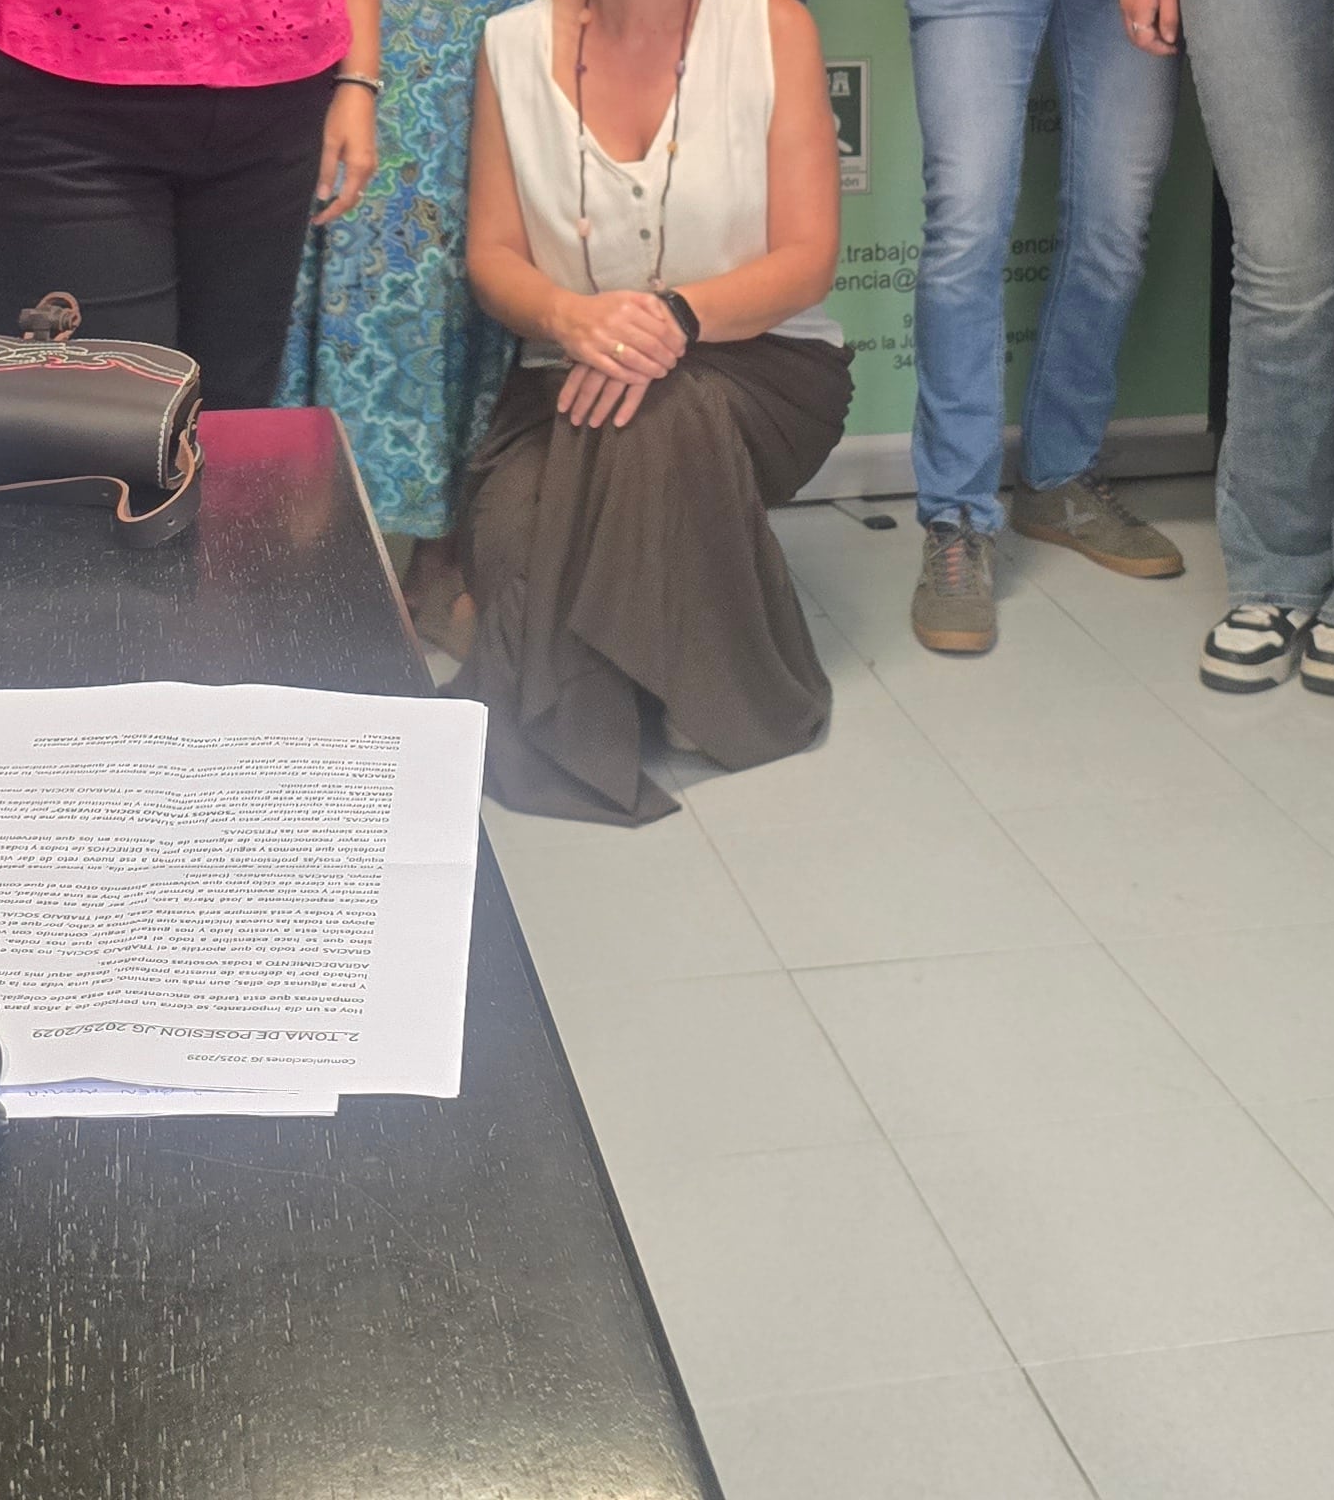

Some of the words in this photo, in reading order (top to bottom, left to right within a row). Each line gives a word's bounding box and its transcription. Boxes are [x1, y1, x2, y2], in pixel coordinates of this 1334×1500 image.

[10, 948, 34, 956] solo
[56, 947, 100, 957] SOCIAL,
[102, 943, 153, 956] TRABAJO
[269, 946, 296, 955] todo
[322, 947, 371, 956] GRACIAS
[97, 956, 169, 967] compañeras.
[170, 959, 219, 967] vosotras
[221, 958, 253, 967] todas
[265, 960, 370, 970] AGRADECIMIENTO
[116, 975, 162, 983] camino,
[233, 979, 264, 988] ellas,
[40, 980, 64, 989] vida
[283, 980, 328, 988] algunas
[49, 994, 77, 1002] sede
[125, 988, 191, 999] encuentran
[0, 994, 48, 1003] colegial.
[93, 998, 139, 1008] periodo
[294, 995, 365, 1004] compañeras
[213, 1004, 281, 1013] importante,
[32, 1021, 129, 1039] 2025/2029
[131, 1022, 157, 1035] JG
[159, 1025, 254, 1040] POSESION
[255, 1029, 280, 1041] DE
[285, 1030, 339, 1042] TOMA
[339, 1031, 360, 1042] 2.
[186, 1054, 248, 1063] 2025/2029
[265, 1056, 356, 1066] Comunicaciones
